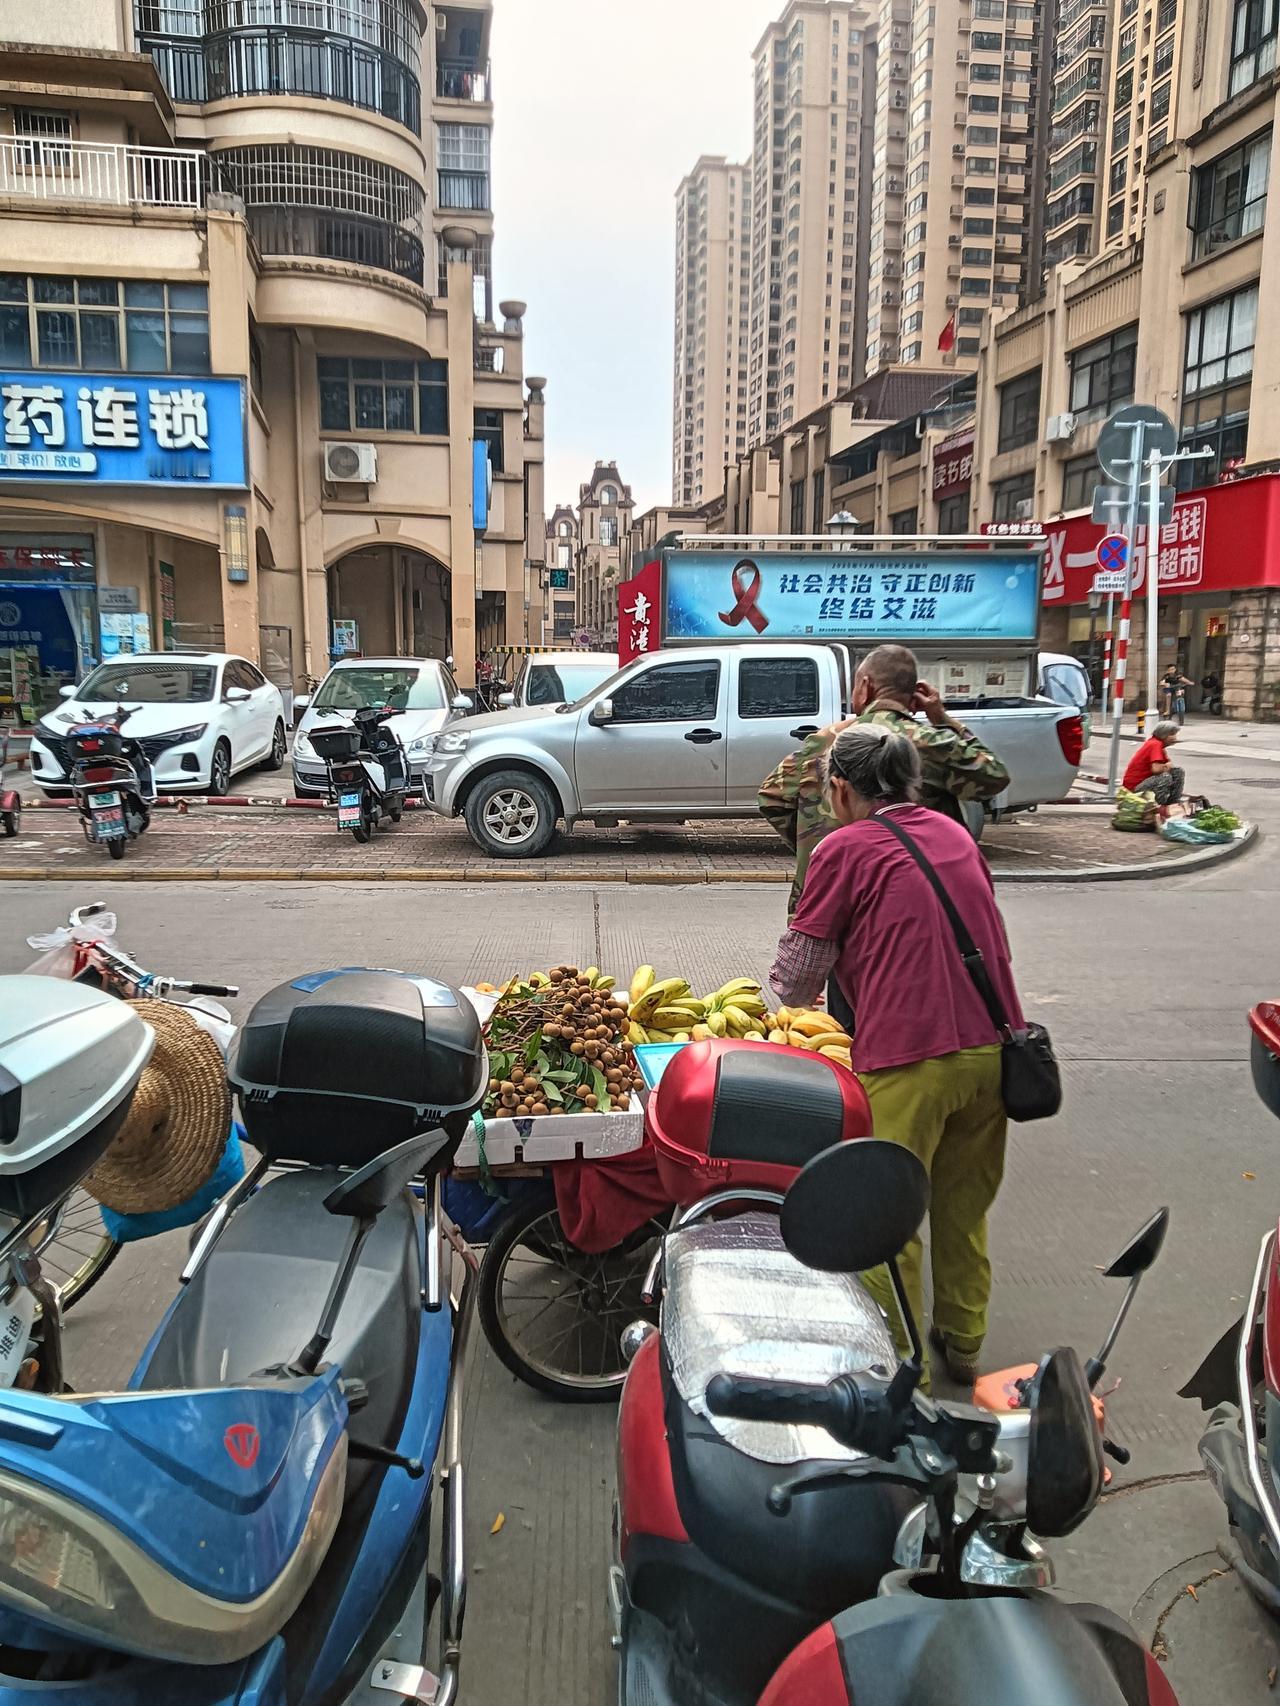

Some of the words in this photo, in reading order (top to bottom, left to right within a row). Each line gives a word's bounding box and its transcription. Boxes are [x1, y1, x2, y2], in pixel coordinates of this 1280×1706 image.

[1, 384, 210, 450] 药连锁
[54, 454, 81, 468] 放心
[1158, 544, 1201, 580] 超市
[779, 574, 873, 594] 社会共治
[880, 573, 977, 594] 守正创新
[818, 597, 938, 620] 终结艾滋
